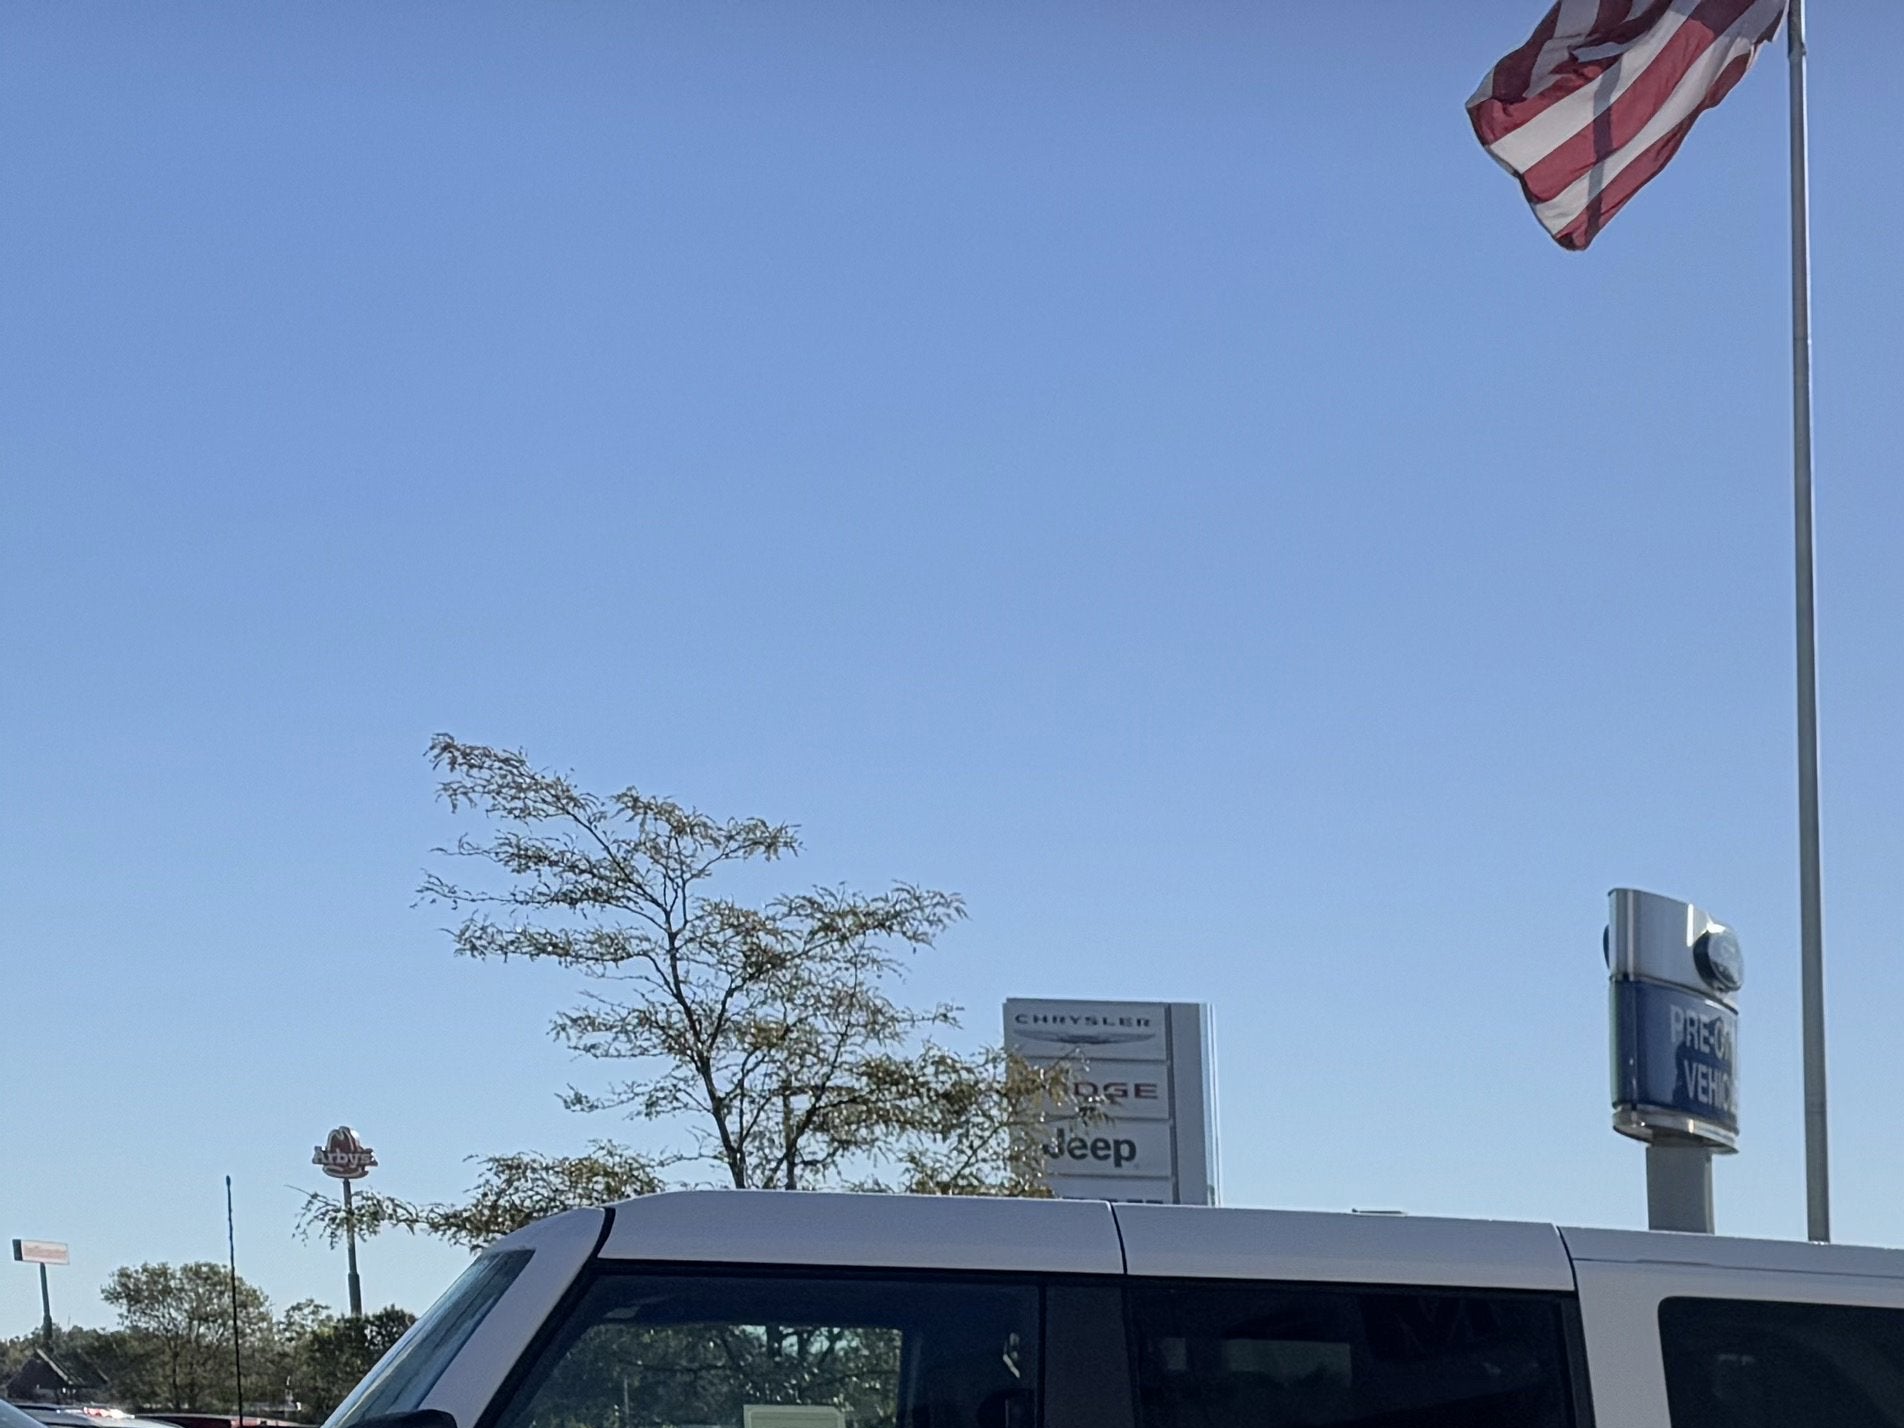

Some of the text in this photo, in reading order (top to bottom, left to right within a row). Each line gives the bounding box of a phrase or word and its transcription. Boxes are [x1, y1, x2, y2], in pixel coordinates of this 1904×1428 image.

[1015, 1013, 1151, 1028] CHRYSLER
[1073, 1081, 1159, 1101] DGE
[1042, 1128, 1138, 1169] Jeep
